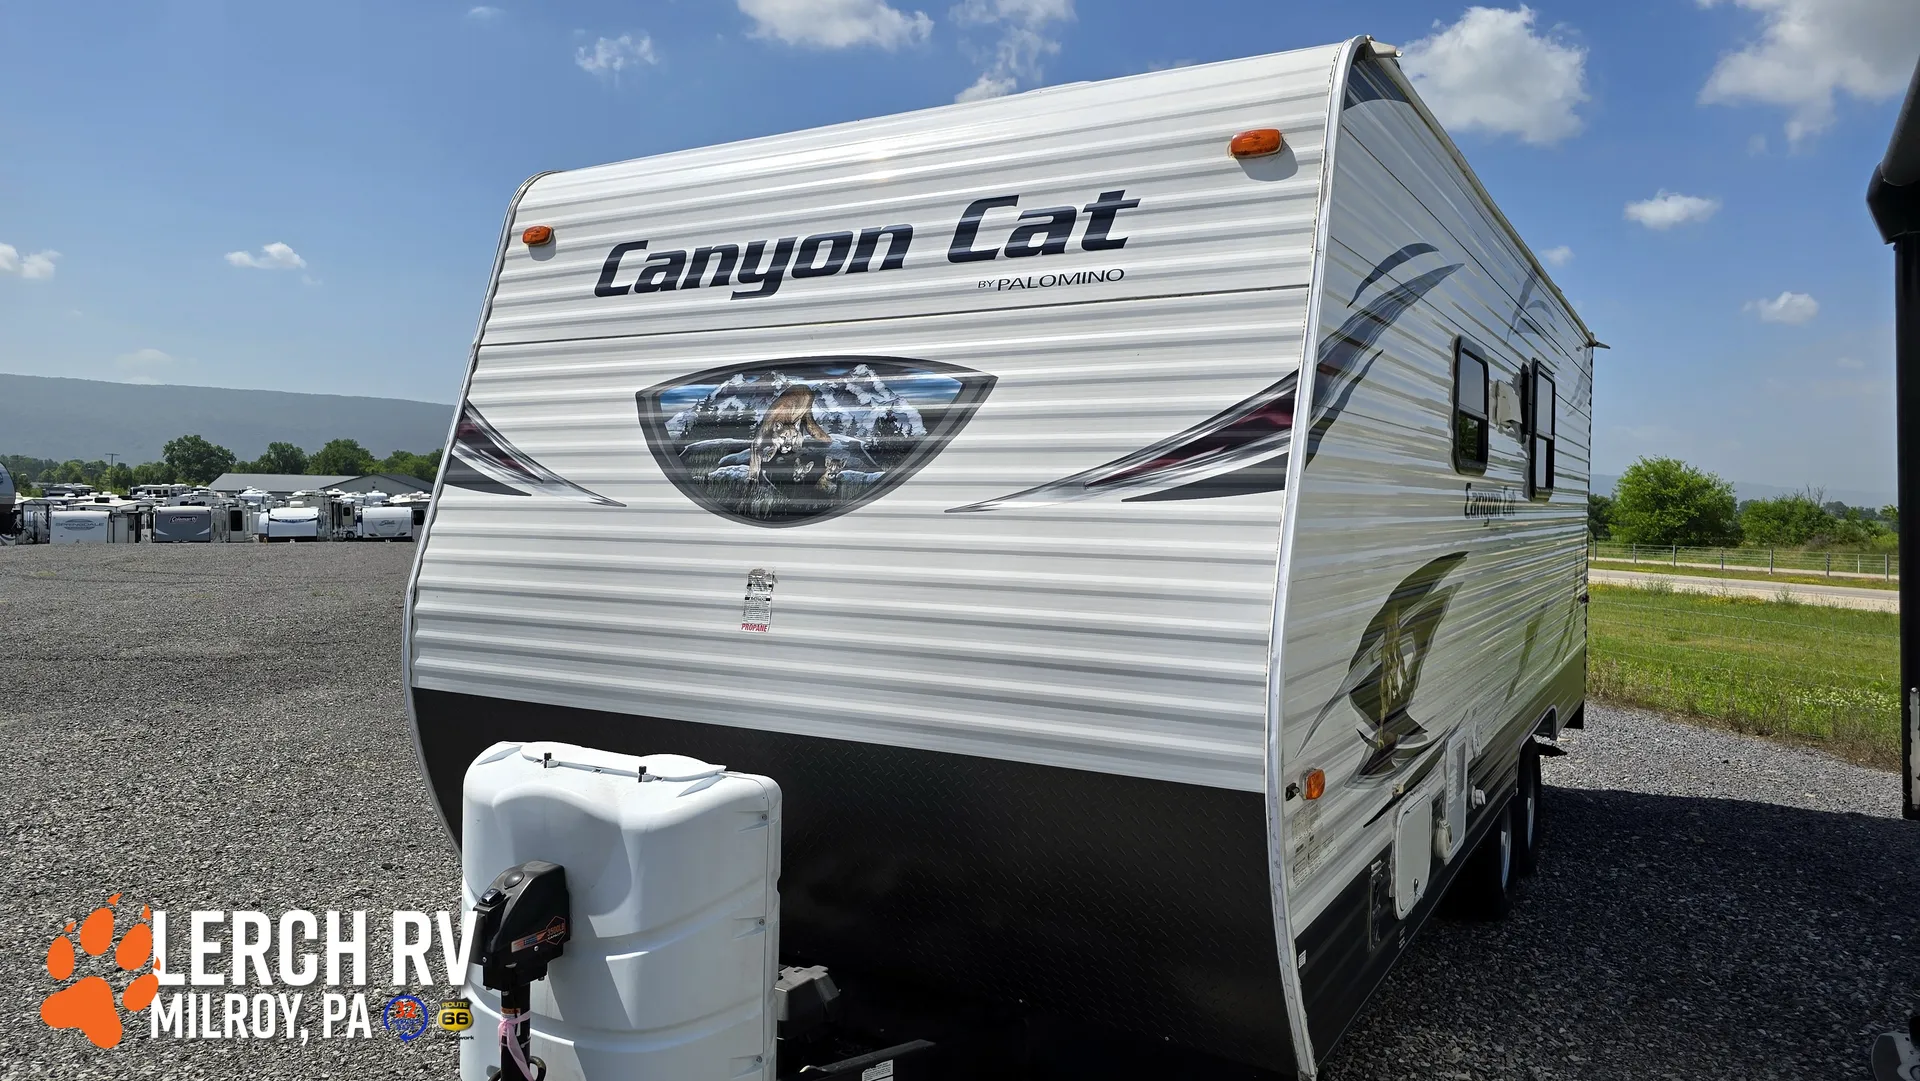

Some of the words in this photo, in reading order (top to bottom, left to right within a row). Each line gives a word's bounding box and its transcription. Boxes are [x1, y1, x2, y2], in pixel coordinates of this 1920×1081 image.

[594, 223, 914, 300] Canyon
[947, 190, 1141, 263] Cat
[977, 279, 995, 289] BY
[997, 268, 1125, 291] PALOMINO
[1464, 482, 1502, 527] Canyon
[741, 623, 768, 632] PROPANE
